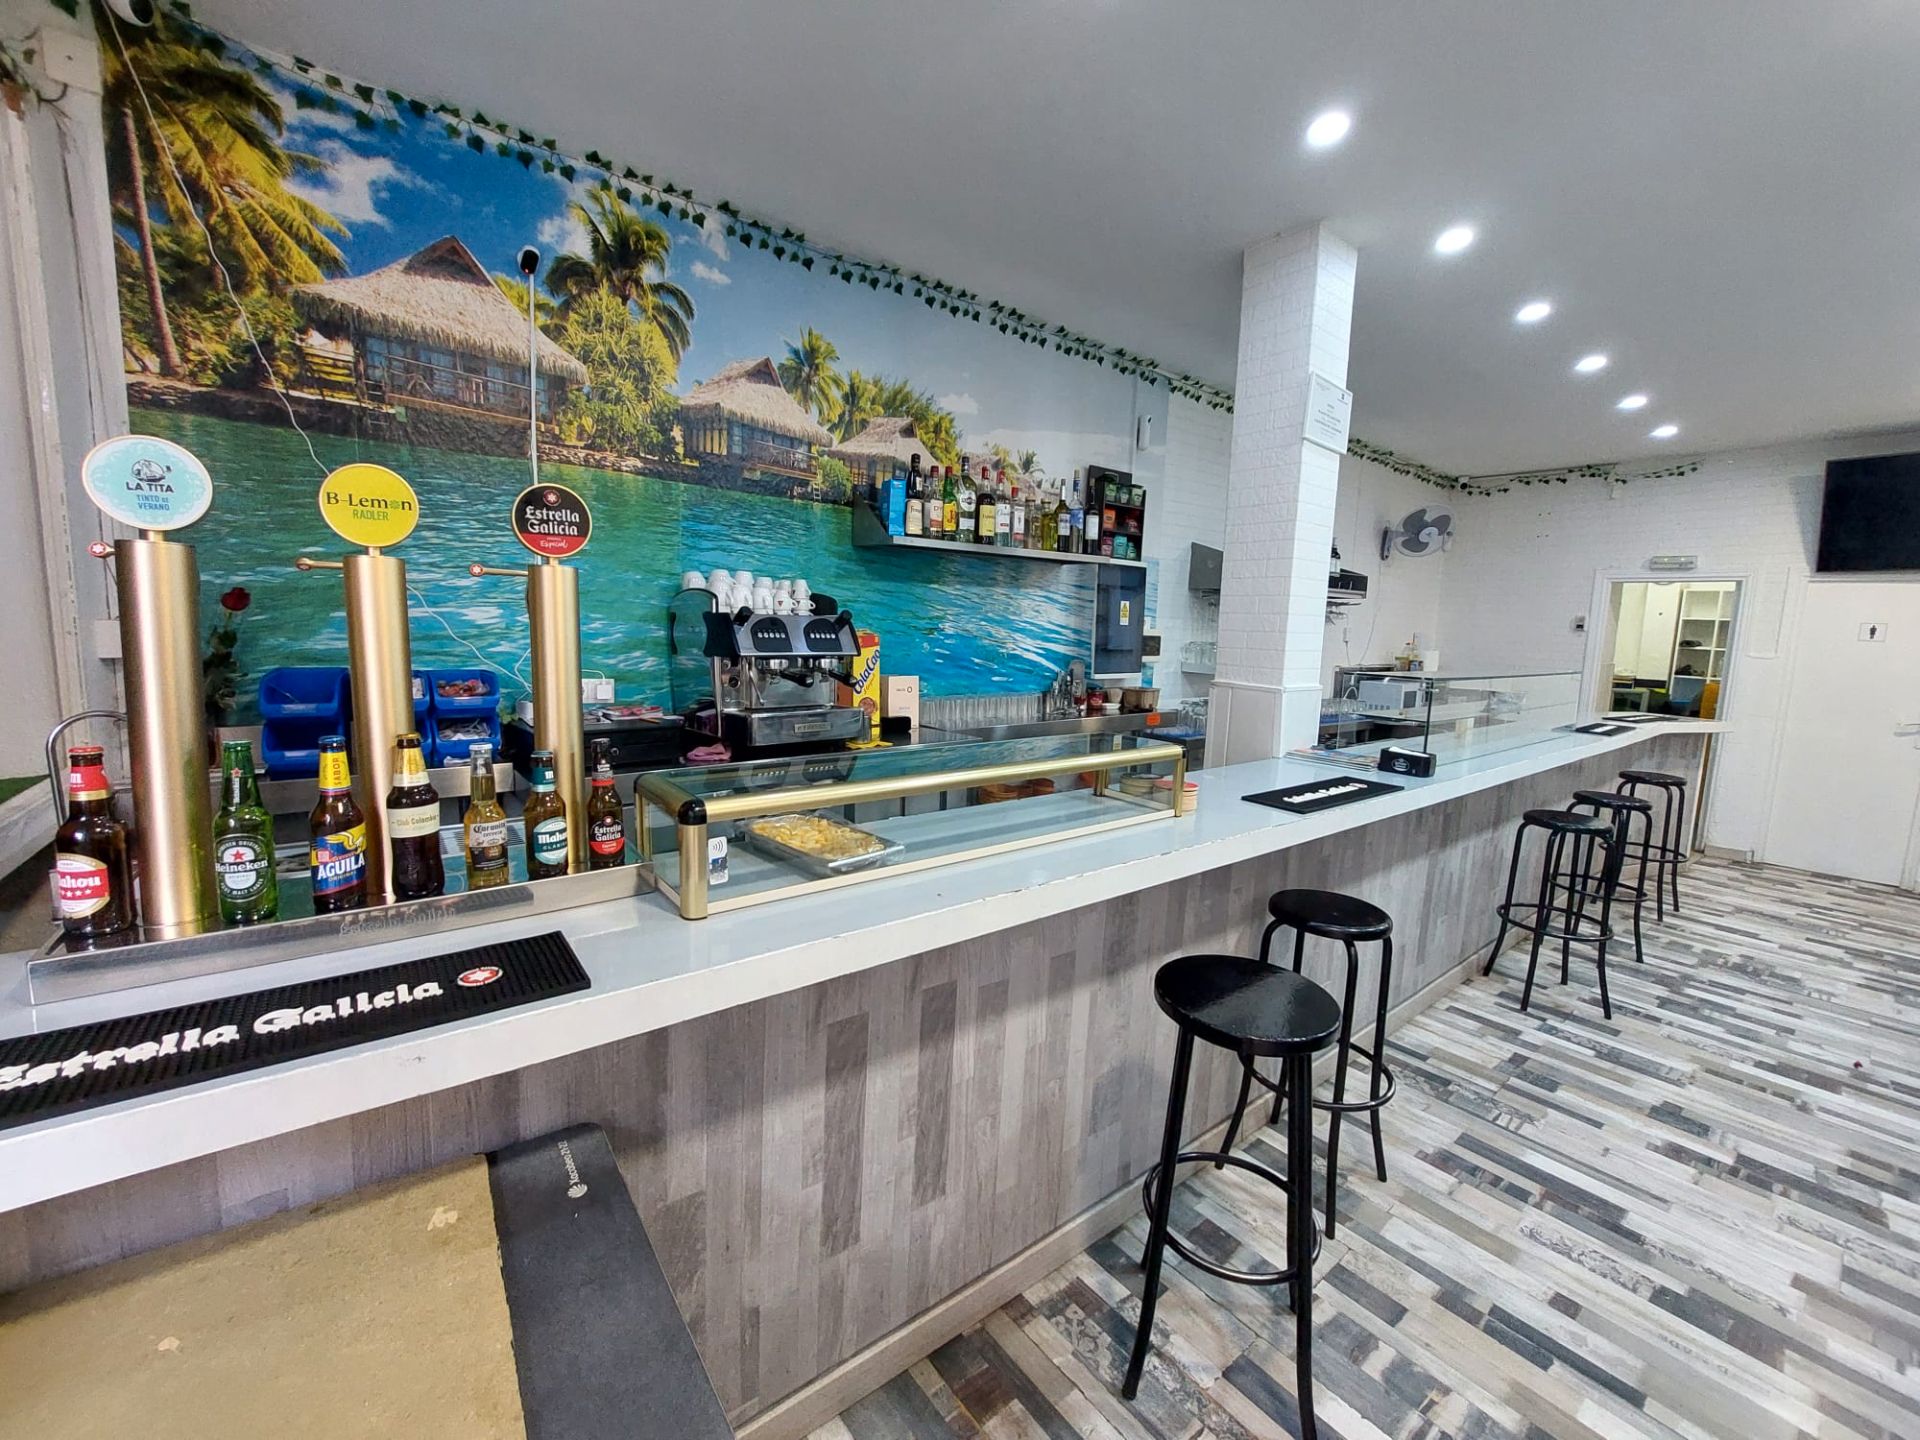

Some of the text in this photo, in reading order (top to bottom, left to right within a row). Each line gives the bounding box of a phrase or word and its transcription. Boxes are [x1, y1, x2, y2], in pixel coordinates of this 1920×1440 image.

[126, 481, 174, 493] LA TITA
[353, 509, 389, 521] RADLER
[525, 505, 579, 523] Estrella
[527, 519, 578, 536] Galicia
[853, 648, 880, 695] ColaCao
[332, 757, 342, 786] SABOR
[594, 824, 622, 834] Estrella
[595, 832, 621, 842] Galicia
[215, 859, 269, 873] Heineken
[317, 852, 366, 881] AGUILA
[253, 981, 445, 1035] Galicia
